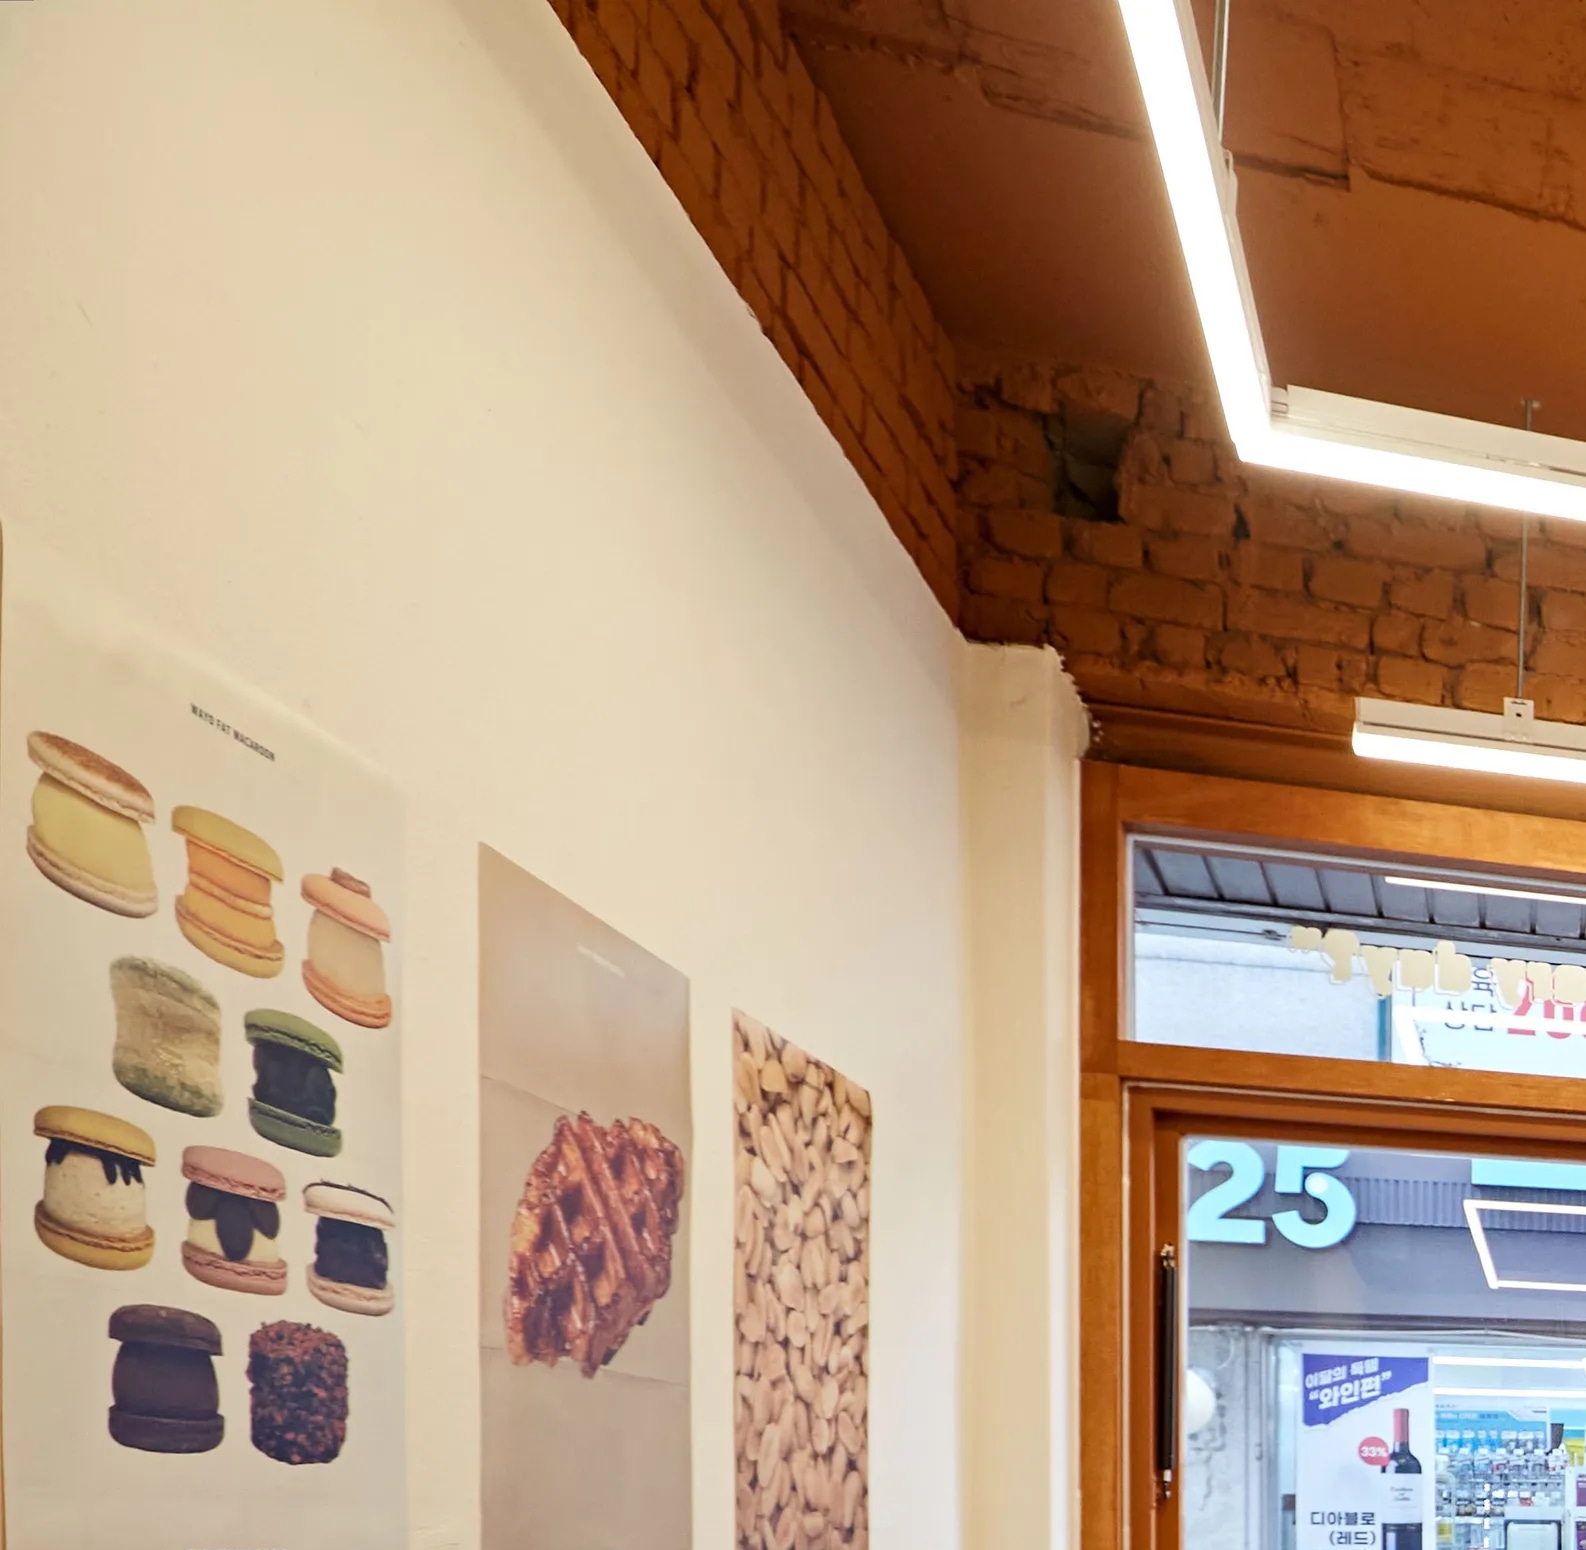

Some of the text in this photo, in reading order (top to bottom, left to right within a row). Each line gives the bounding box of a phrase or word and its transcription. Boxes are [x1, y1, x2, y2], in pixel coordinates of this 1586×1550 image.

[1187, 1141, 1357, 1249] 25
[1305, 1365, 1347, 1388] 이달의
[1361, 1446, 1388, 1457] 33%
[1310, 1511, 1376, 1526] 디아블로
[1329, 1531, 1377, 1546] (레드)
